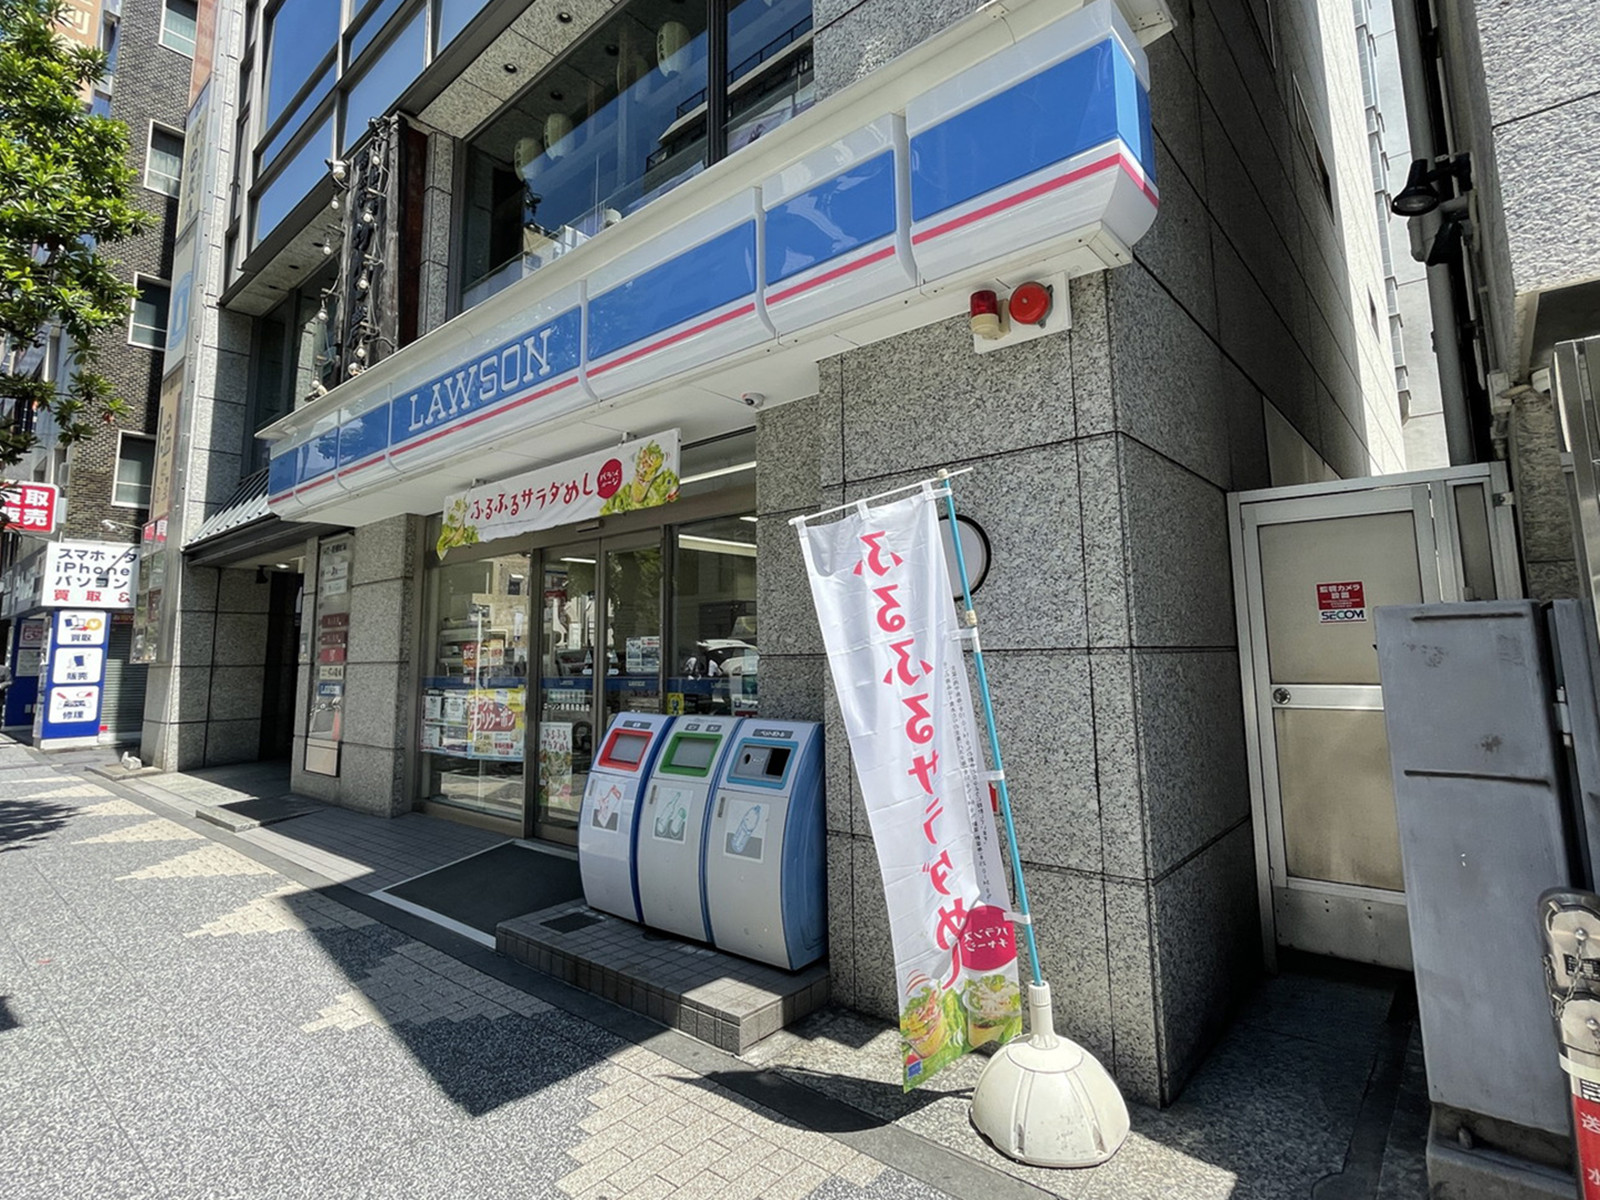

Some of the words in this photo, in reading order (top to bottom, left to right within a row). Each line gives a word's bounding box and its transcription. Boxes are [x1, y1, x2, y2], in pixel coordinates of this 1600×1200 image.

[407, 328, 552, 432] LAWSON
[470, 472, 593, 520] ふるふるサラダめし
[56, 561, 130, 576] iPhone
[55, 575, 128, 589] パソコン
[1321, 609, 1364, 621] SECOM
